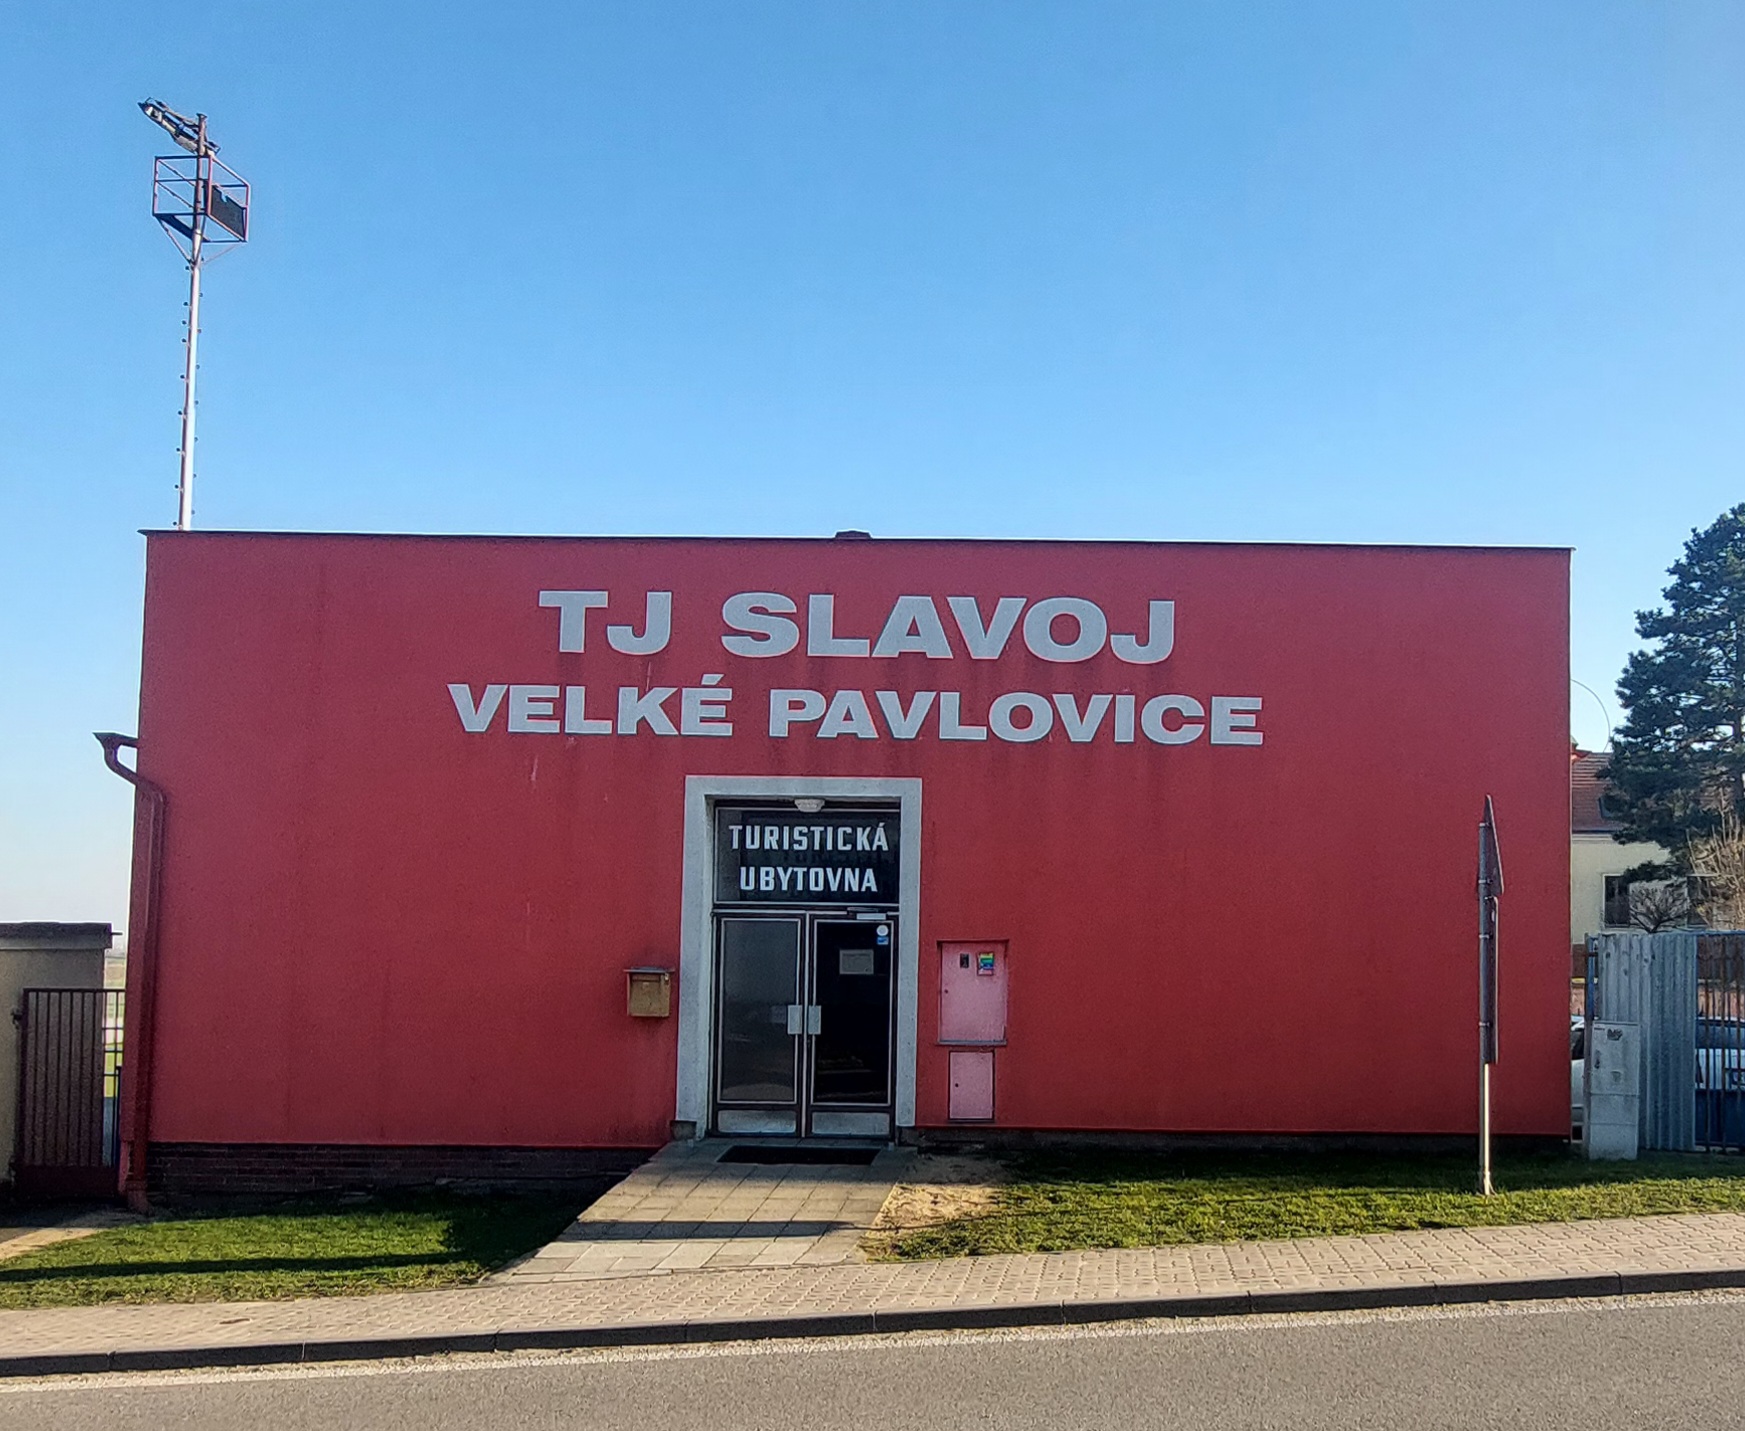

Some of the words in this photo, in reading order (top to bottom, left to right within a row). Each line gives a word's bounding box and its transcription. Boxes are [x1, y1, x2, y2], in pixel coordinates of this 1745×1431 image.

[538, 590, 673, 656] TJ
[721, 592, 1176, 665] SLAVOJ
[446, 673, 734, 738] VELKÉ
[768, 688, 1265, 747] PAVLOVICE
[728, 822, 890, 852] TURISTICKÁ
[739, 866, 878, 893] UBYTOVNA
